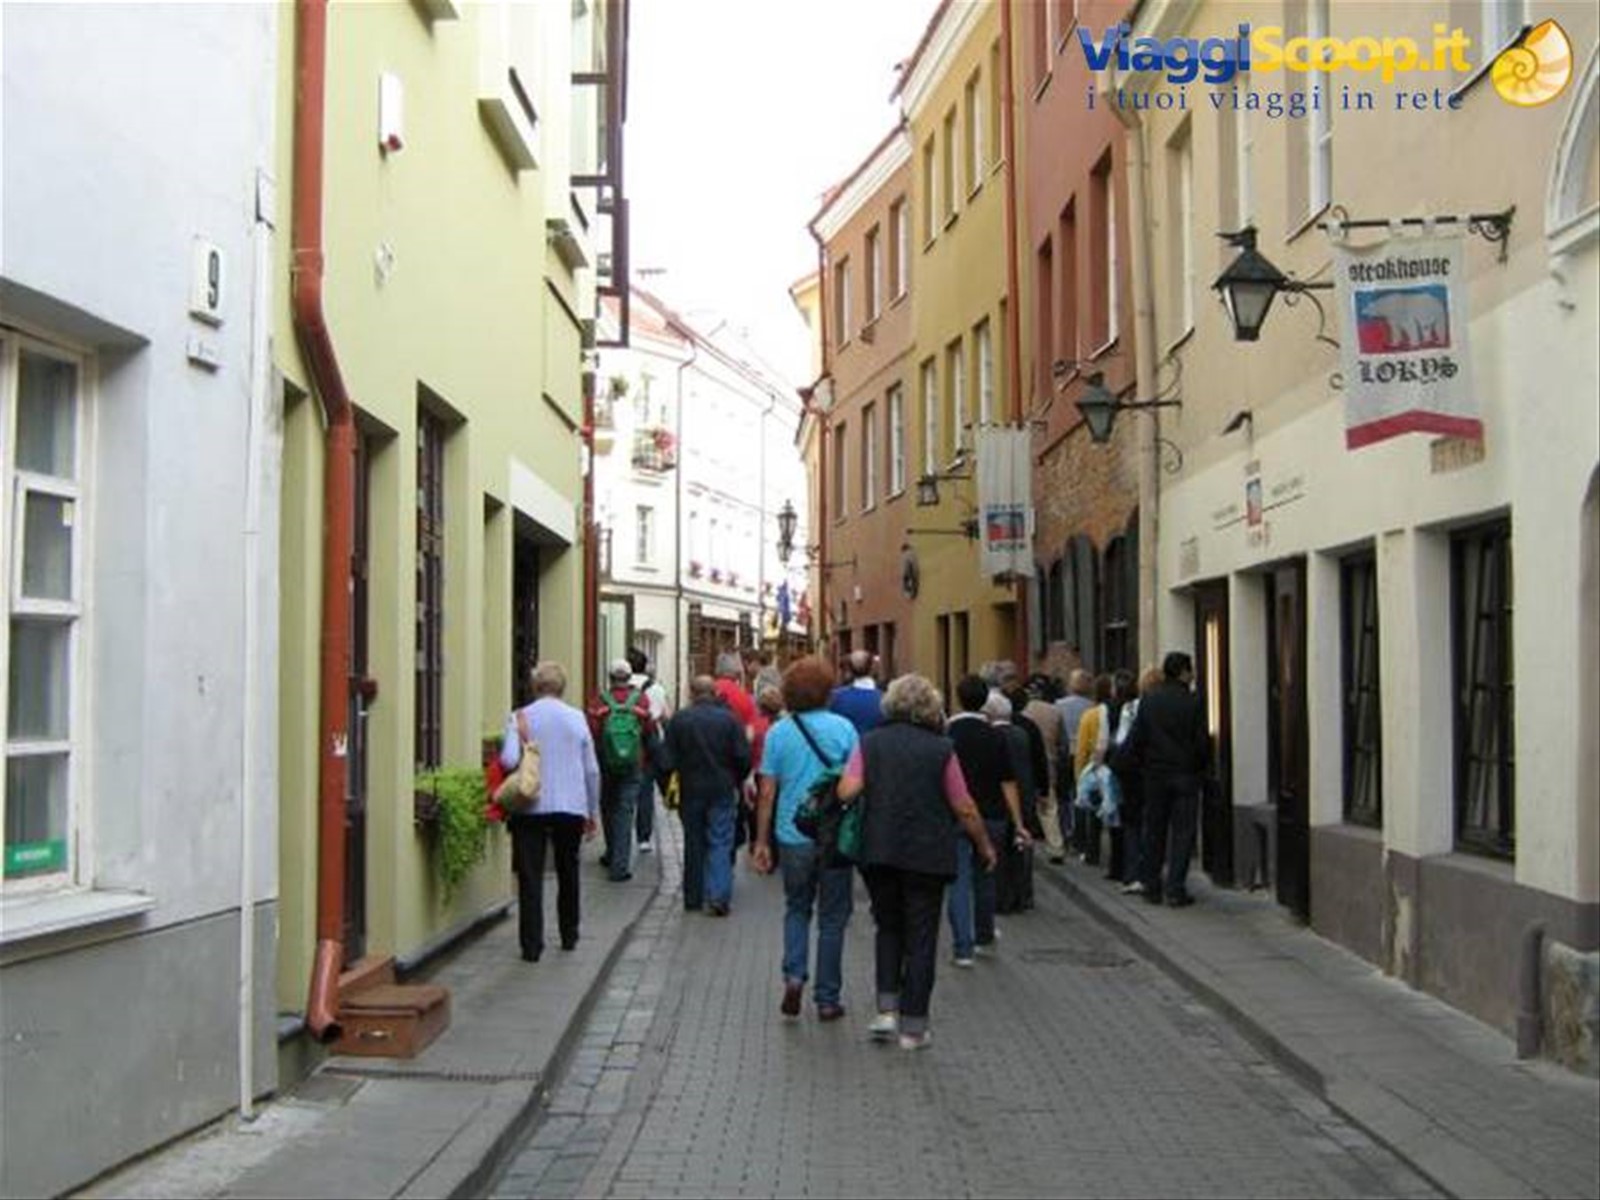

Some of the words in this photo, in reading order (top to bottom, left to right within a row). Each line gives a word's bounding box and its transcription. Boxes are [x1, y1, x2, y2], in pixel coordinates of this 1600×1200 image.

[208, 250, 219, 309] 9
[1349, 257, 1451, 282] steakhouse
[1357, 356, 1458, 384] LOKYS
